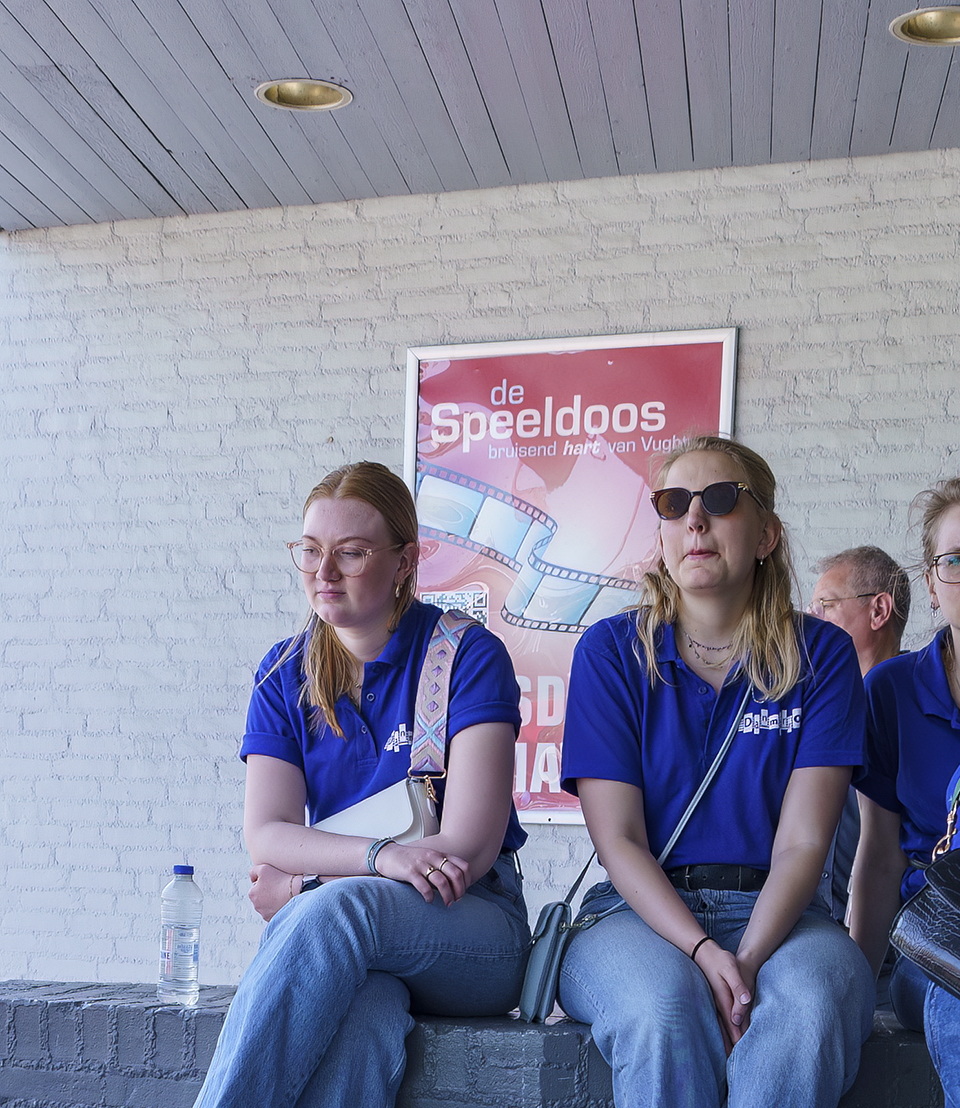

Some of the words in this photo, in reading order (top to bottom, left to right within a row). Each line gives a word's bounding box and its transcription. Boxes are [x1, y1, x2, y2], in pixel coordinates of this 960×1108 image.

[490, 378, 524, 406] de
[430, 394, 666, 453] Speeldoos
[488, 443, 557, 459] bruisend
[562, 439, 601, 455] hart
[608, 440, 637, 454] van
